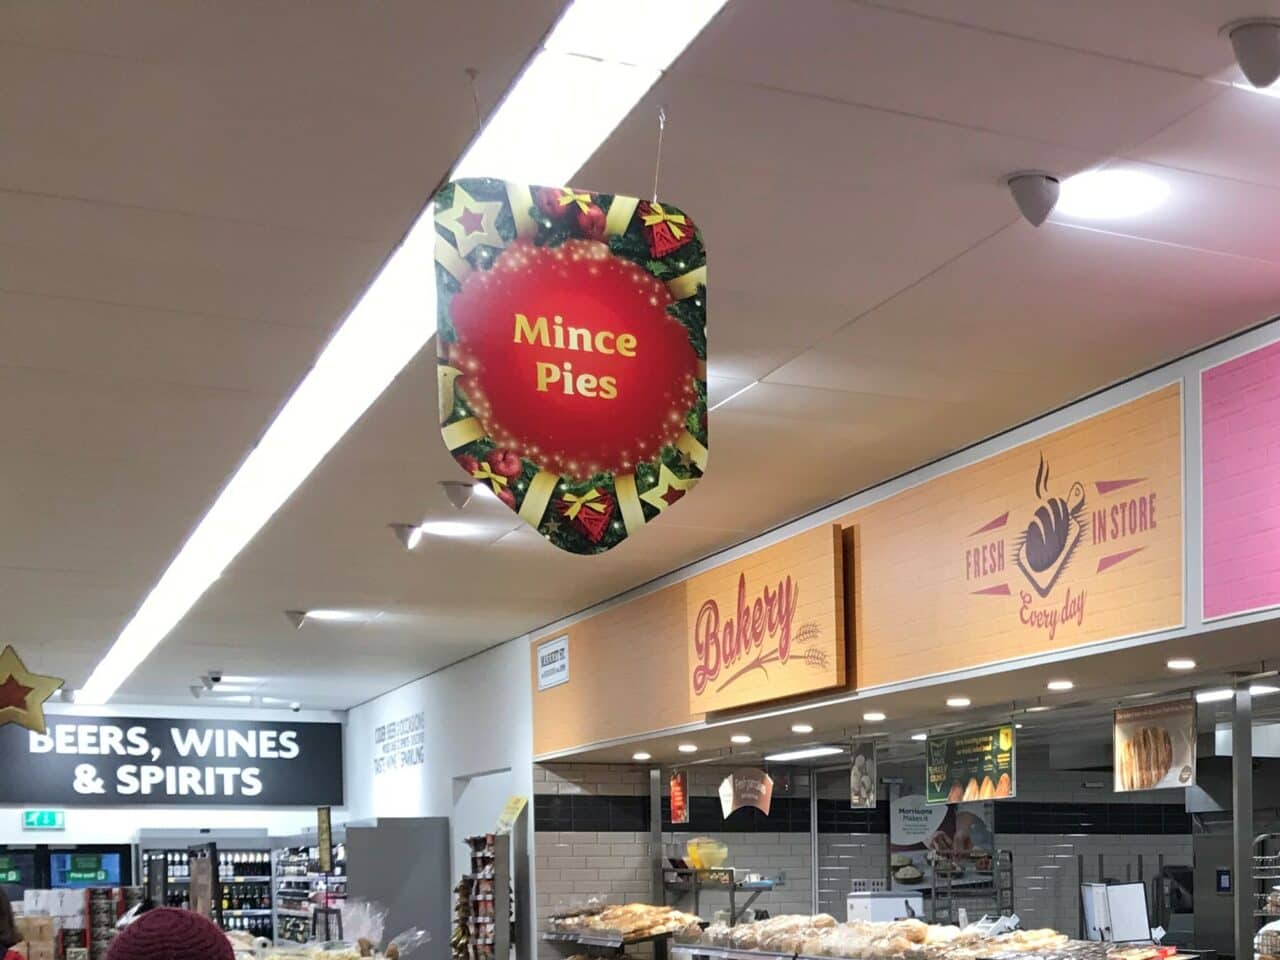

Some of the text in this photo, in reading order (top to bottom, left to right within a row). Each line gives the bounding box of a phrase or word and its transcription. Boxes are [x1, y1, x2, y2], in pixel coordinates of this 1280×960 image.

[513, 313, 638, 357] Mince
[535, 361, 618, 400] Pies
[966, 493, 1157, 580] FRESH IN STORE
[693, 572, 797, 695] Bakery
[29, 724, 300, 762] BEERS, WINES
[73, 763, 263, 797] & SPIRITS
